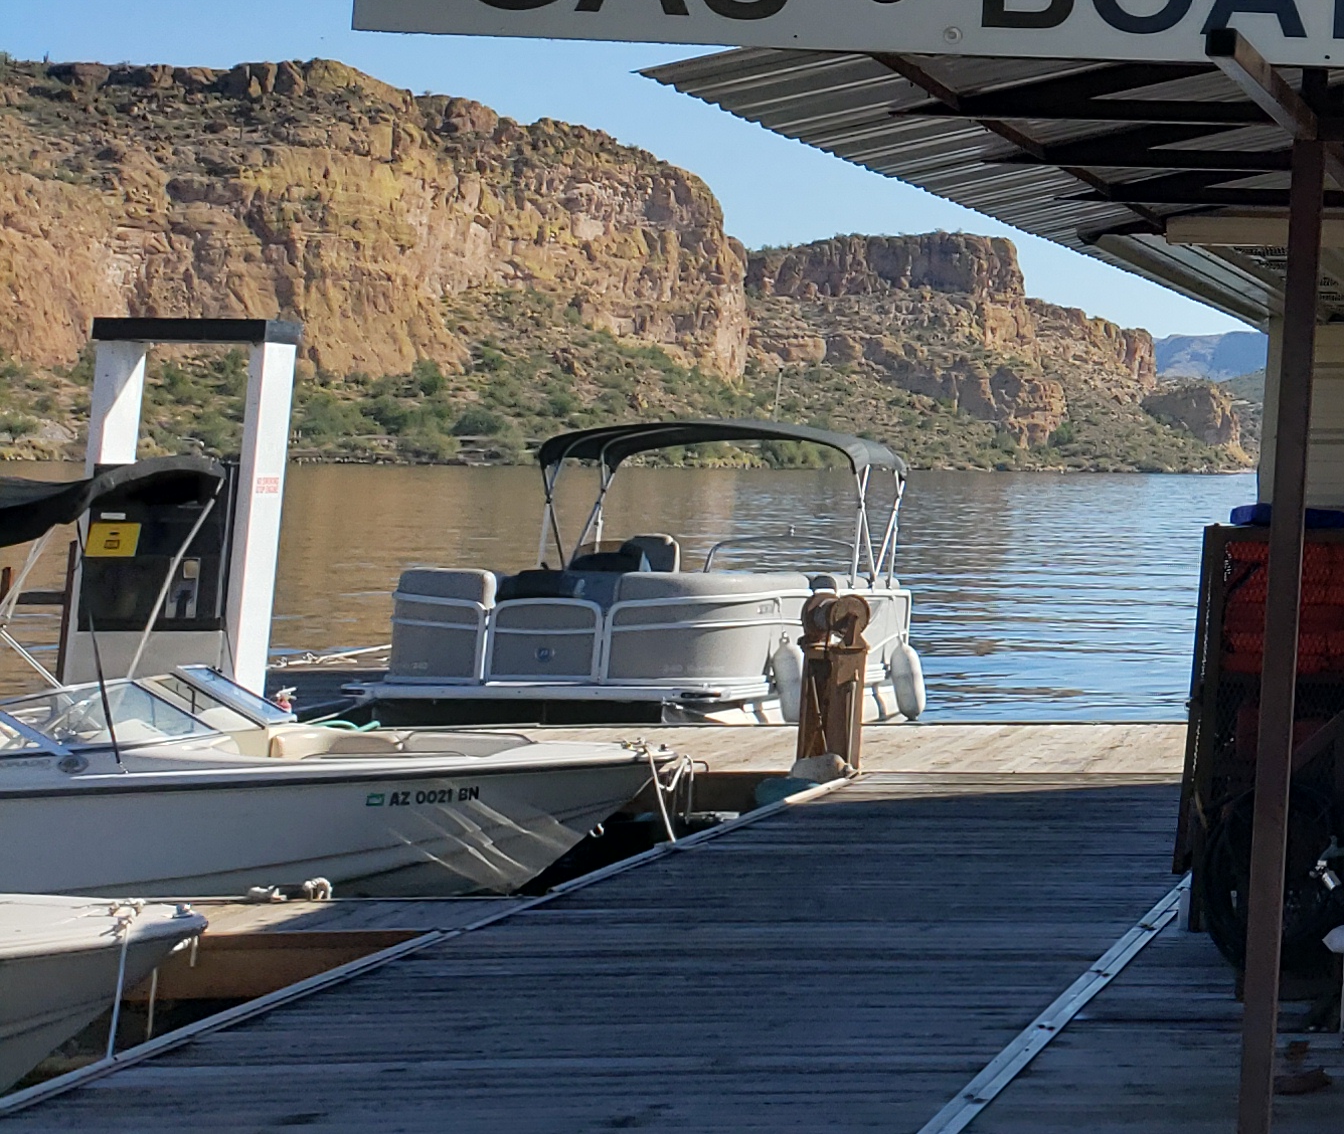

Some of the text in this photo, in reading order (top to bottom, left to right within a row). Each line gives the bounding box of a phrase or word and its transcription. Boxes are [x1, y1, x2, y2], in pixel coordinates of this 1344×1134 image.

[389, 786, 480, 807] AZ 0021 BN
